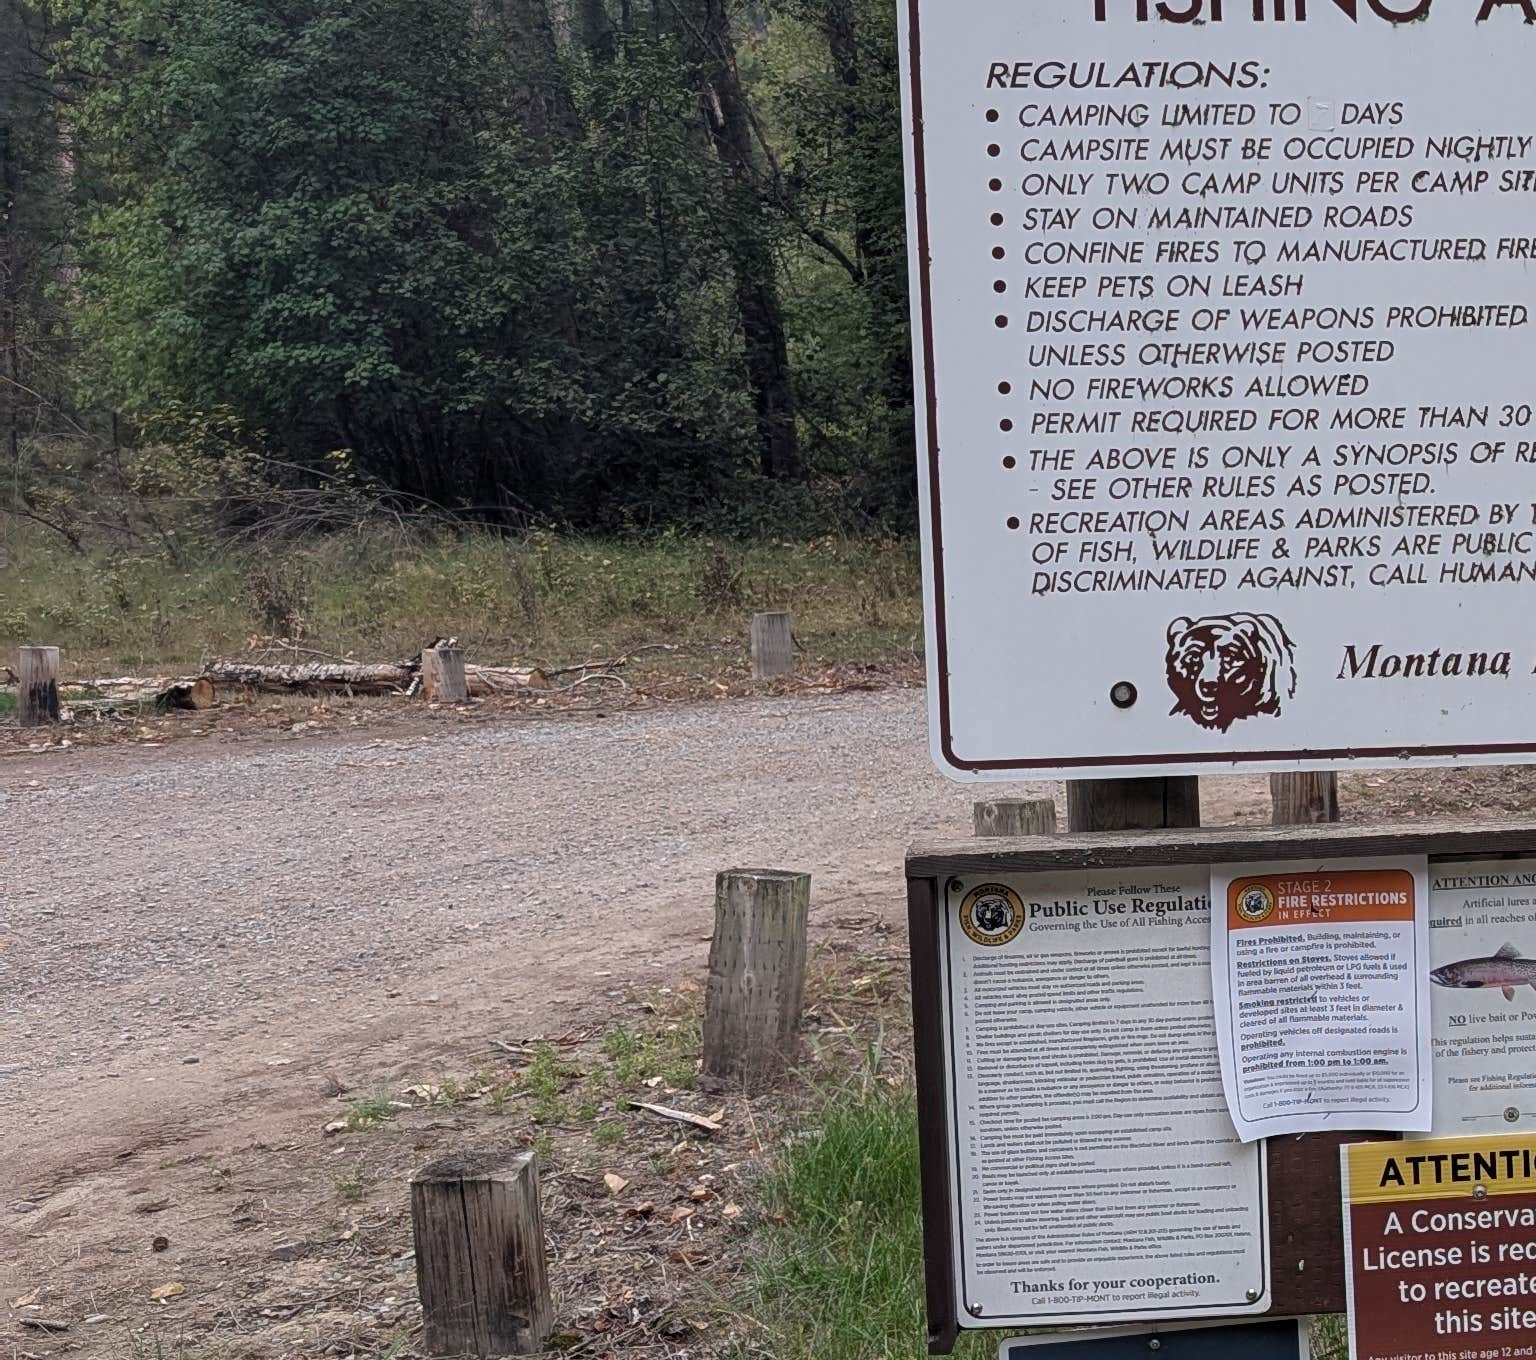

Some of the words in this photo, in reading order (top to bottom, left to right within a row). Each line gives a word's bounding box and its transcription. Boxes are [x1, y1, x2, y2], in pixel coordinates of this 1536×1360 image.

[987, 61, 1269, 89] REGULATIONS:
[1019, 104, 1149, 128] CAMPING
[1162, 104, 1255, 127] LIMITED
[1269, 103, 1301, 125] TO
[1341, 103, 1403, 124] DAYS
[1021, 139, 1149, 161] CAMPSITE
[1160, 138, 1232, 165] MUST
[1241, 138, 1272, 164] BE
[1284, 137, 1414, 160] OCCUPIED
[1426, 136, 1532, 163] NIGHTLY
[1023, 208, 1081, 232] STAY
[1093, 208, 1137, 229] ON
[1148, 207, 1312, 229] MAINTAINED
[1324, 205, 1412, 227] ROADS
[1025, 242, 1144, 264] CONFINE
[1156, 241, 1219, 262] FIRES
[1233, 241, 1266, 265] TO
[1277, 239, 1486, 262] MANUFACTURED
[1025, 277, 1086, 298] KEEP
[1098, 276, 1153, 300] PETS
[1167, 275, 1211, 297] ON
[1223, 274, 1303, 296] LEASH
[1027, 309, 1179, 332] DISCHARGE
[1192, 309, 1230, 331] OF
[1240, 307, 1374, 330] WEAPONS
[1387, 305, 1527, 328] PROHIBITED
[1030, 379, 1074, 400] NO
[1087, 376, 1233, 401] FIREWORKS
[1245, 374, 1368, 397] ALLOWED
[1031, 412, 1121, 433] PERMIT
[1132, 410, 1257, 433] REQUIRED
[1269, 409, 1319, 430] FOR
[1330, 408, 1406, 429] MORE
[1419, 406, 1488, 428] THAN
[1499, 405, 1532, 426] 30
[1336, 645, 1510, 679] Montana
[1277, 880, 1320, 895] STAGE
[1323, 879, 1333, 892] 2
[1431, 873, 1510, 890] ATTENTION
[1029, 900, 1087, 918] Public
[1093, 898, 1128, 915] Use
[1277, 894, 1309, 910] FIRE
[1311, 891, 1409, 908] RESTRICTIONS
[1278, 910, 1290, 921] IN
[1293, 908, 1331, 919] EFFECT
[1448, 1014, 1468, 1027] NO
[1468, 1014, 1487, 1024] live
[1488, 1012, 1507, 1023] bait
[1508, 1014, 1519, 1022] or
[1384, 1212, 1403, 1235] A
[1363, 1247, 1462, 1270] License
[1471, 1241, 1490, 1263] is
[1009, 1279, 1065, 1294] Thanks
[1068, 1278, 1090, 1291] for
[1092, 1279, 1127, 1294] your
[1129, 1272, 1221, 1290] cooperation.
[1399, 1280, 1426, 1302] to
[1435, 1309, 1482, 1334] this
